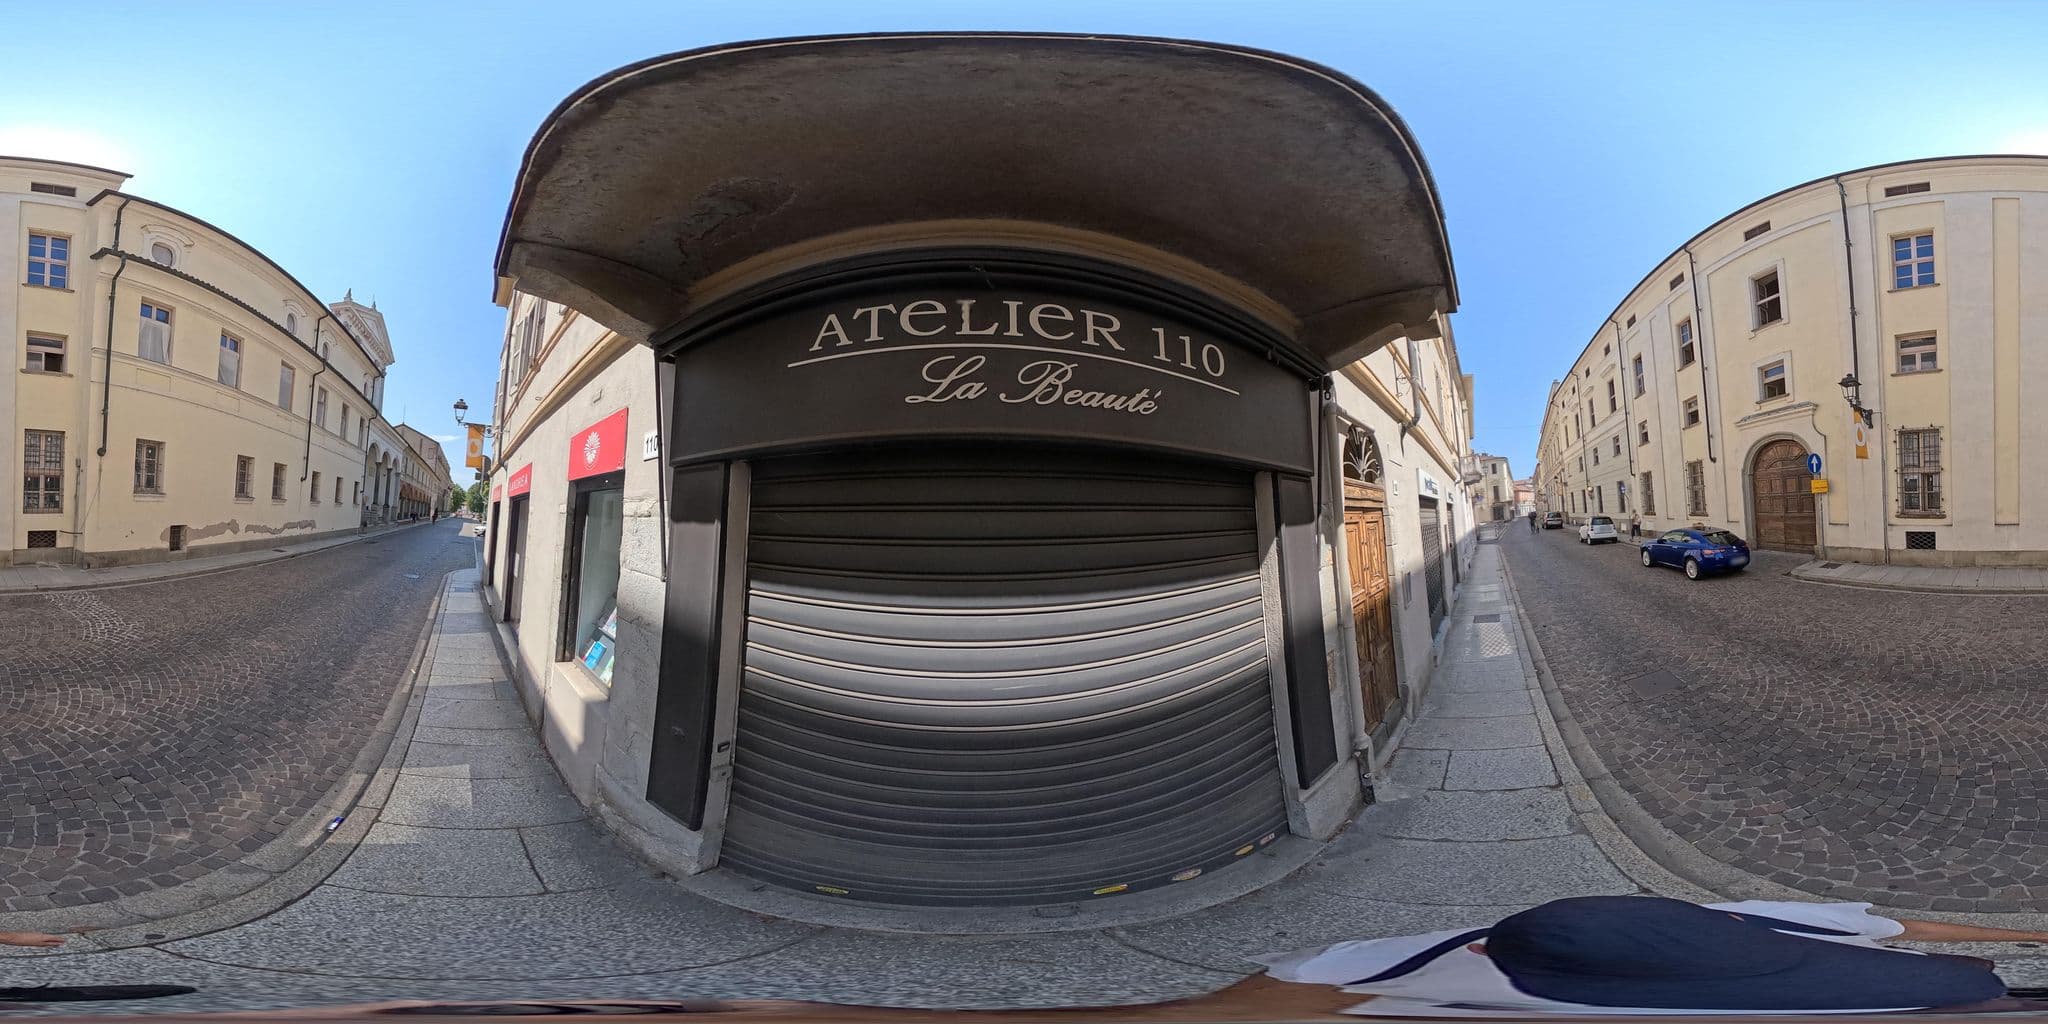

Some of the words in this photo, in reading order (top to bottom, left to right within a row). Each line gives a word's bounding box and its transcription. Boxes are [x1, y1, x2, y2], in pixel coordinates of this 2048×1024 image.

[1151, 327, 1225, 377] 110
[904, 355, 988, 404] La
[999, 360, 1162, 415] Beauté
